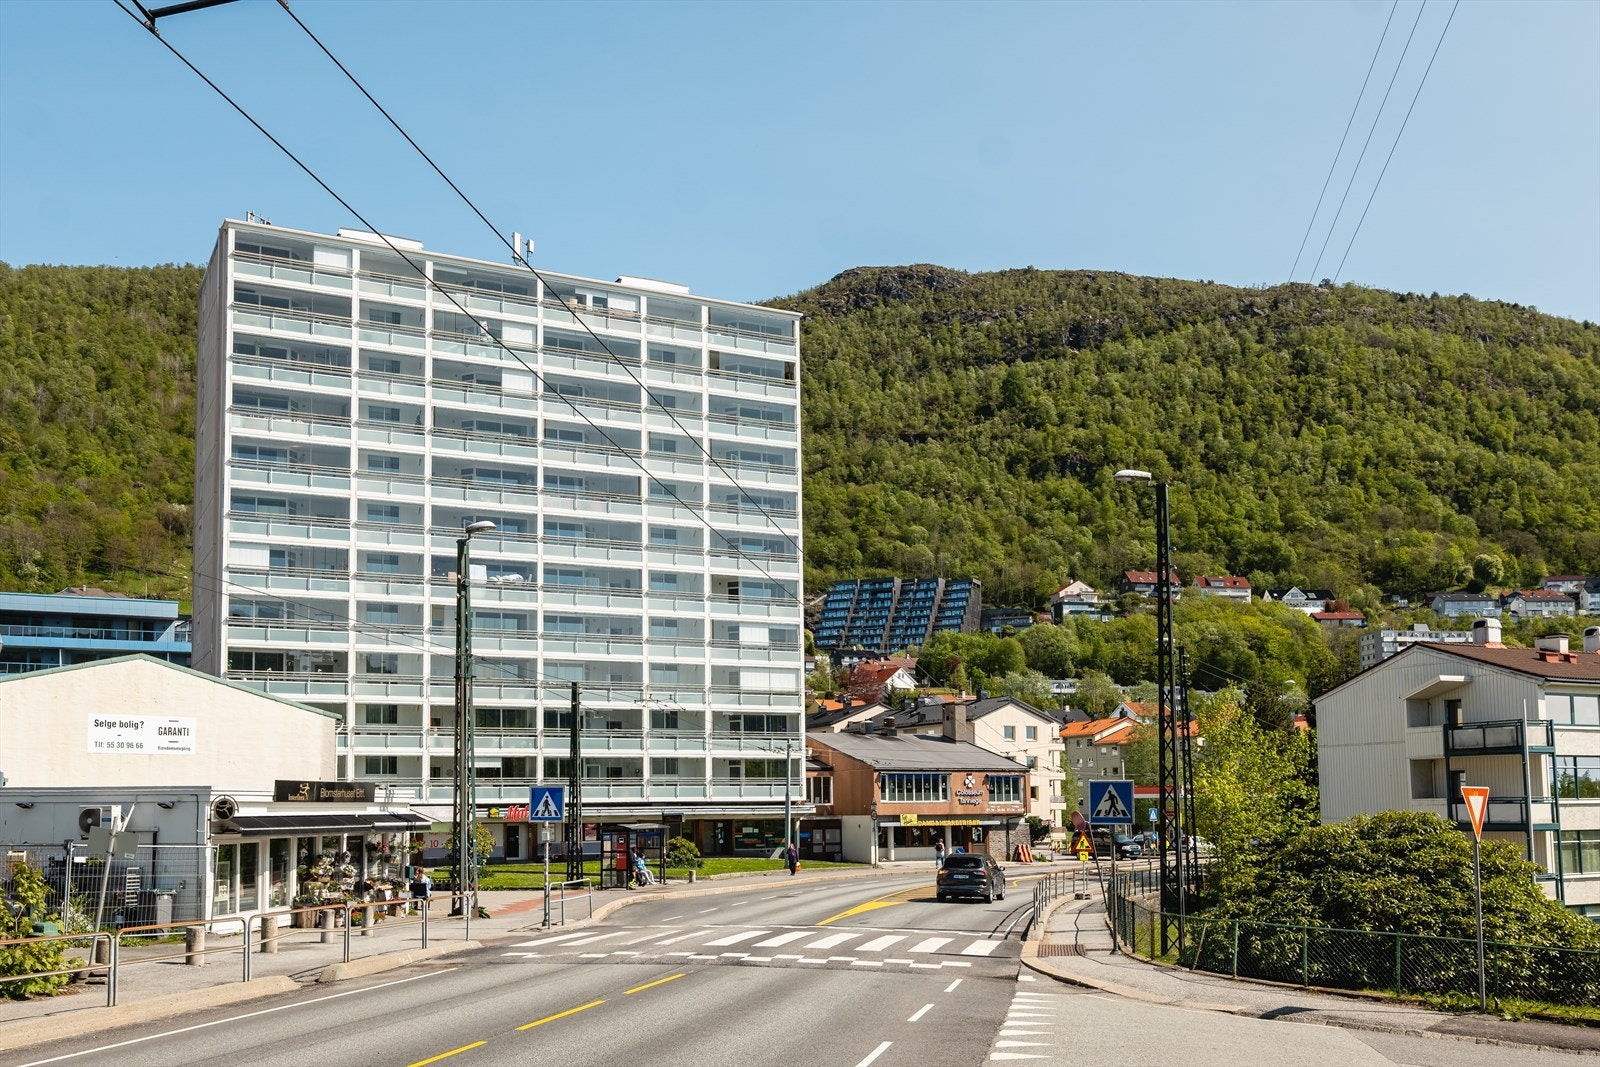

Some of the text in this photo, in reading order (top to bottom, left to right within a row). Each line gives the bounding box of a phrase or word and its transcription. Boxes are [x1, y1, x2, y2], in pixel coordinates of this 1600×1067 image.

[94, 719, 144, 730] Selge bolig?
[157, 726, 189, 736] GARANTI
[106, 741, 115, 749] 55
[116, 741, 125, 749] 30
[430, 839, 439, 848] 10
